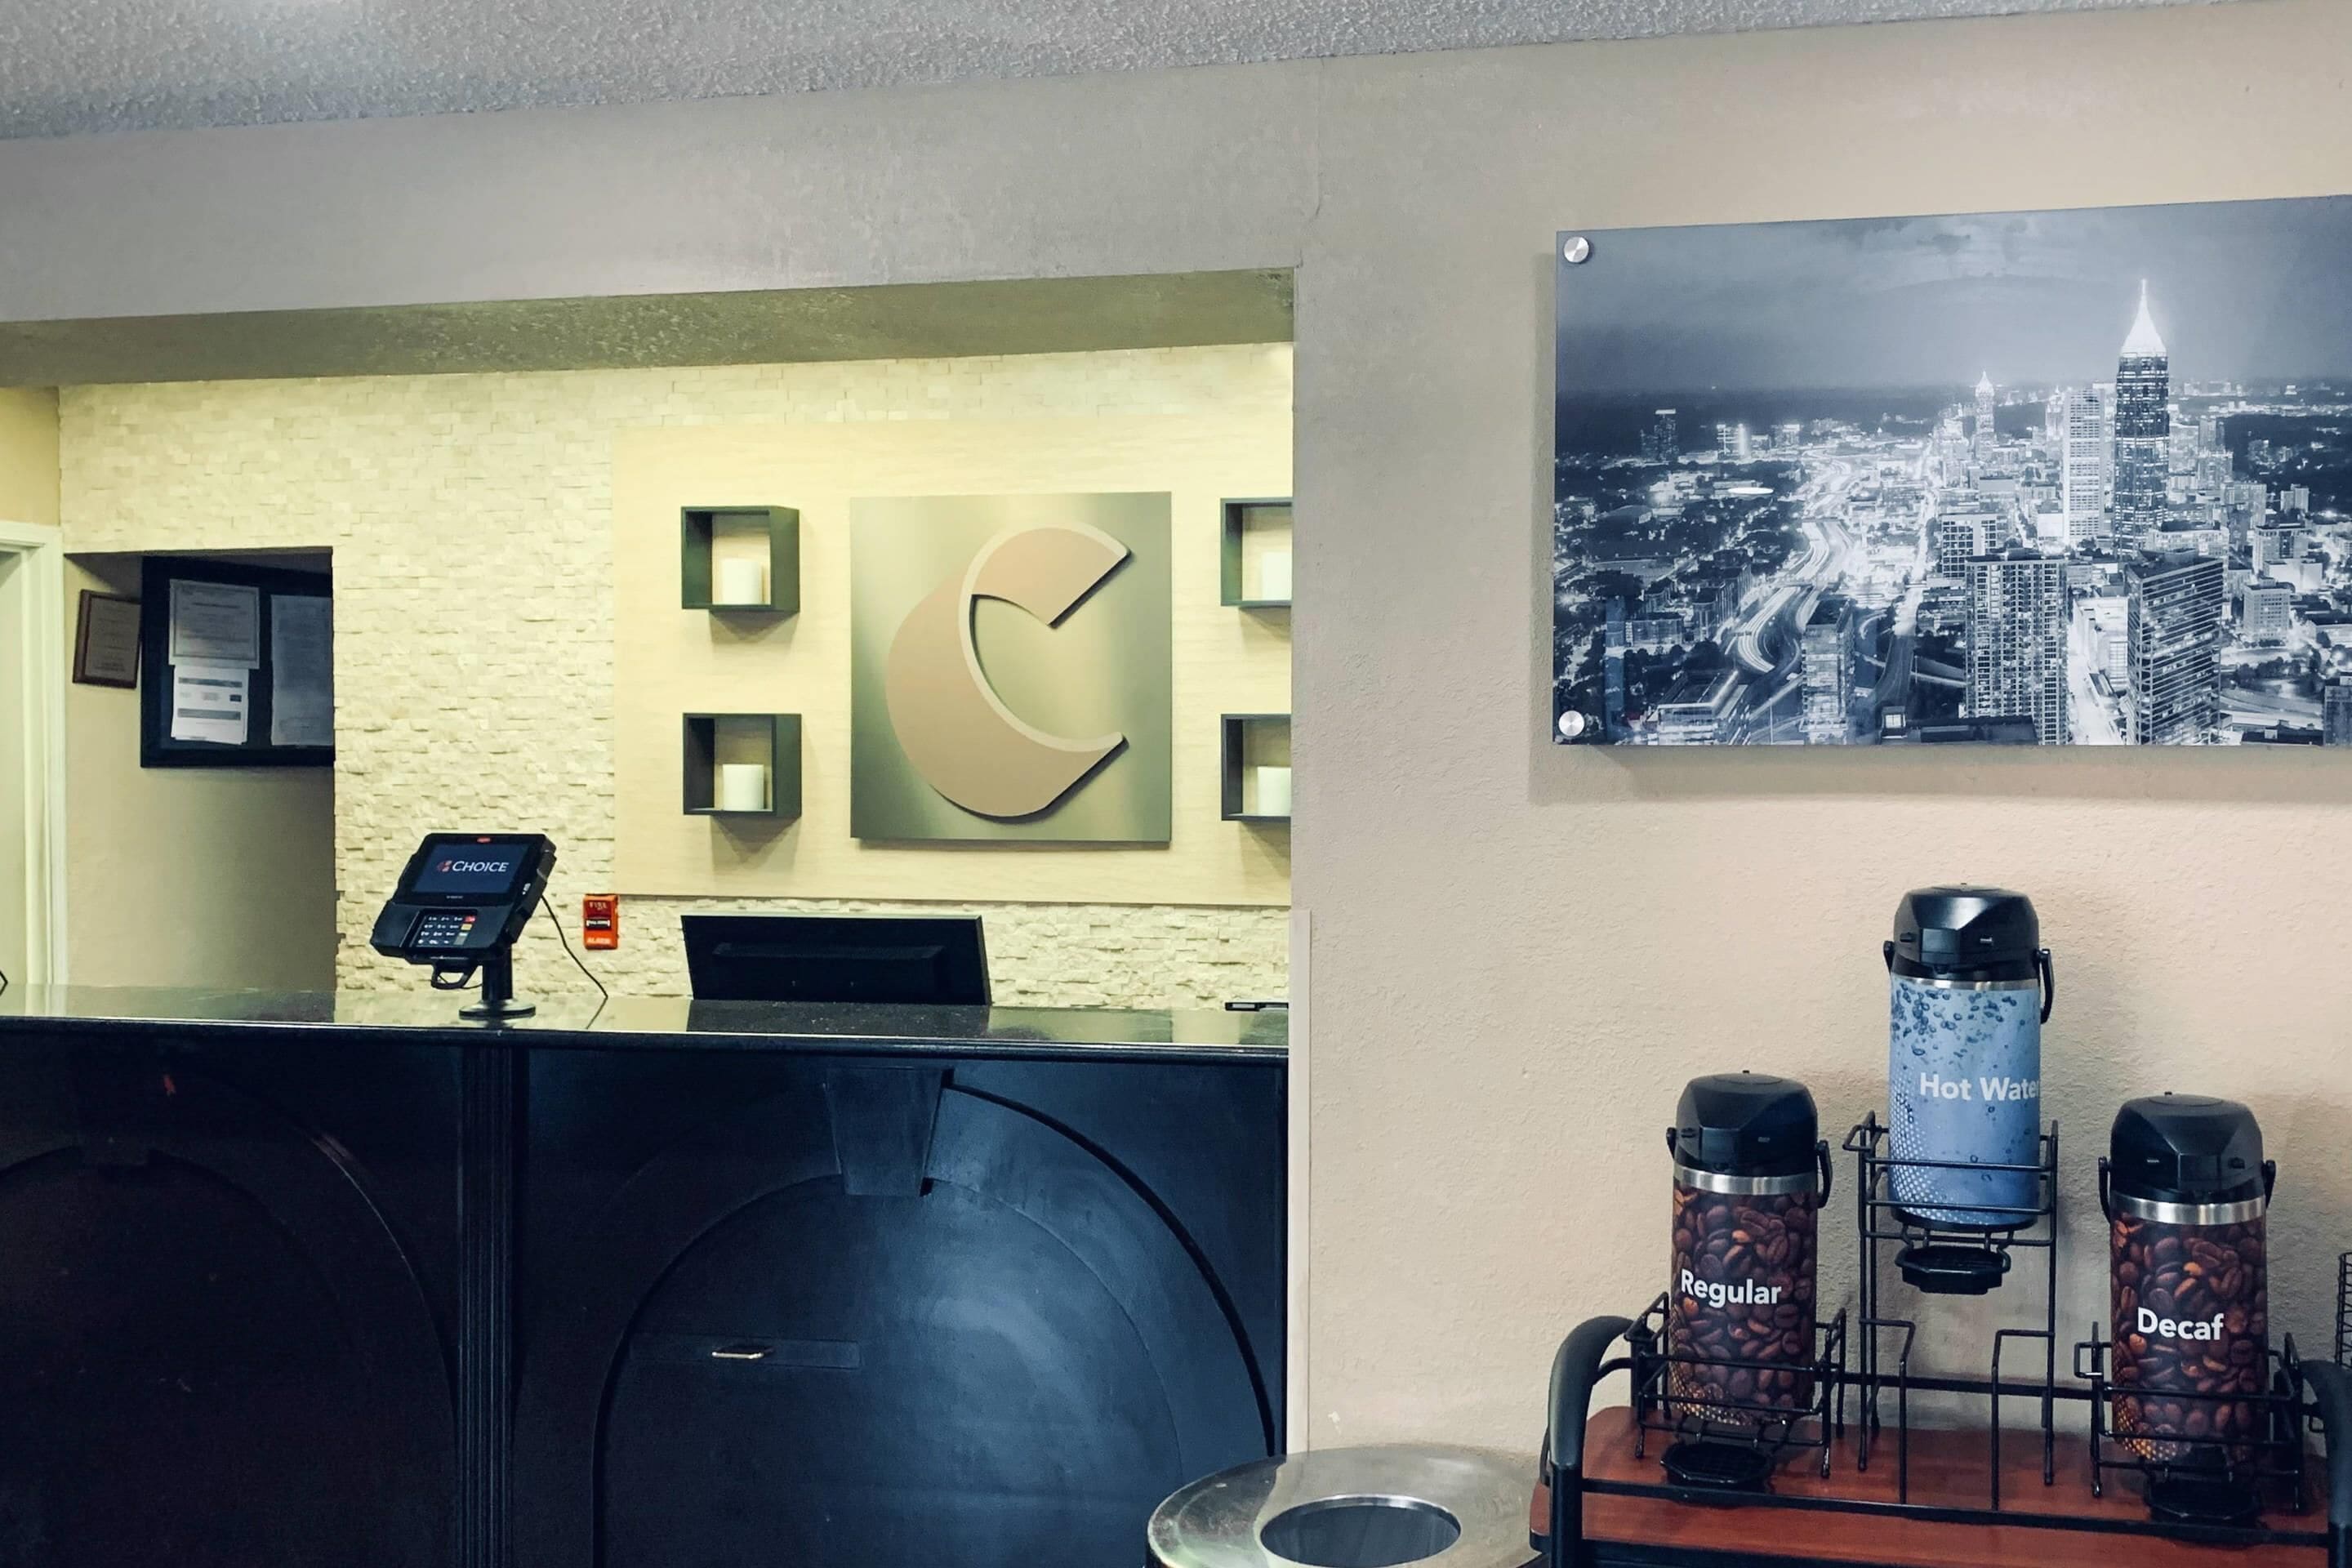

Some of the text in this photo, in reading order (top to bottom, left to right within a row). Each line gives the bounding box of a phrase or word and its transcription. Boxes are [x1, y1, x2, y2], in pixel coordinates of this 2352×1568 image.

[452, 861, 509, 872] CHOICE
[1920, 1072, 1971, 1101] Hot
[1682, 1268, 1781, 1308] Regular
[2138, 1307, 2224, 1340] Decaf
